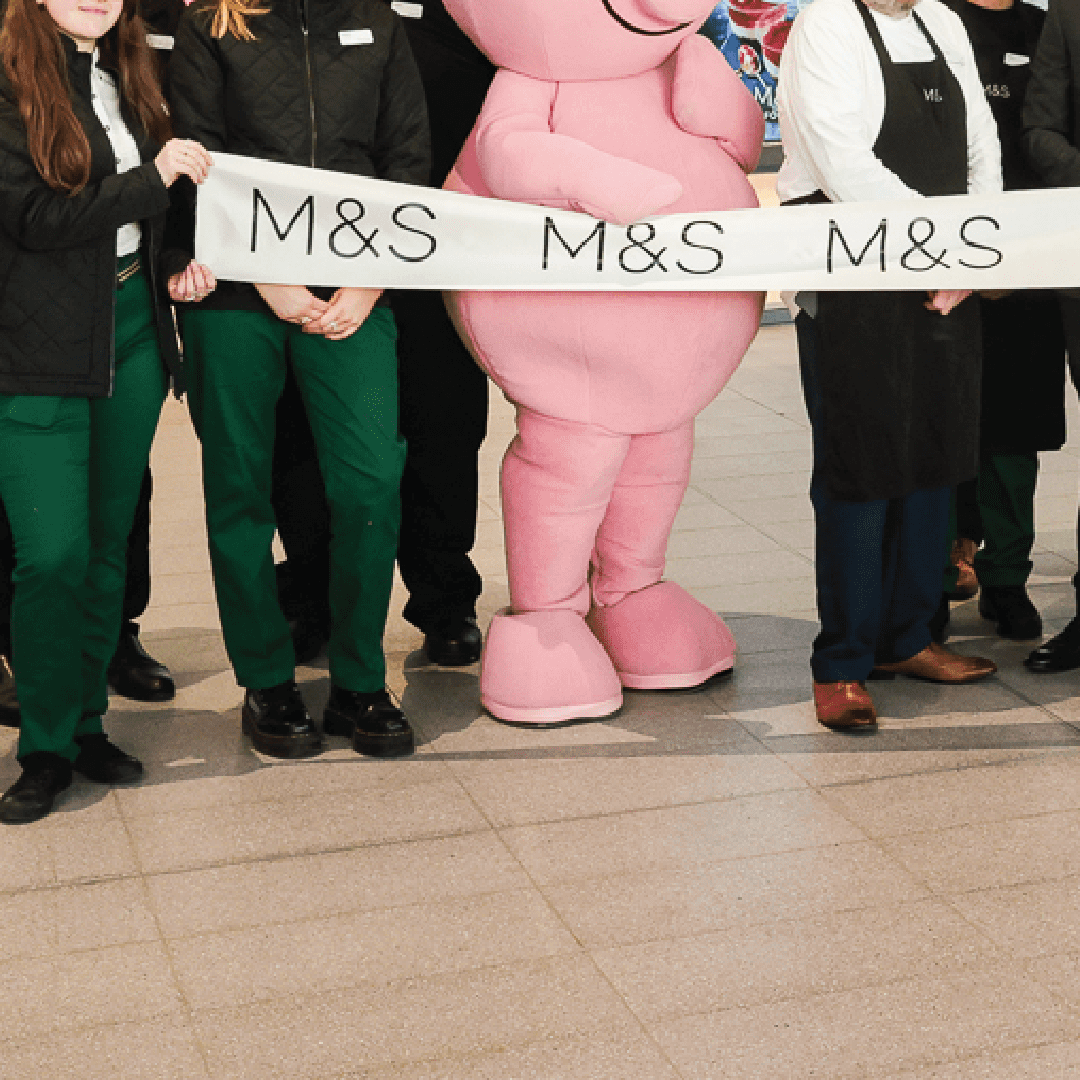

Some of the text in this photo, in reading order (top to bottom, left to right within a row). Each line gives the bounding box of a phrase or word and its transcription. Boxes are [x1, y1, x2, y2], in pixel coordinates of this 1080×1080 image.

[249, 187, 437, 263] M&S
[540, 216, 724, 275] M&S
[826, 215, 1002, 273] M&S
